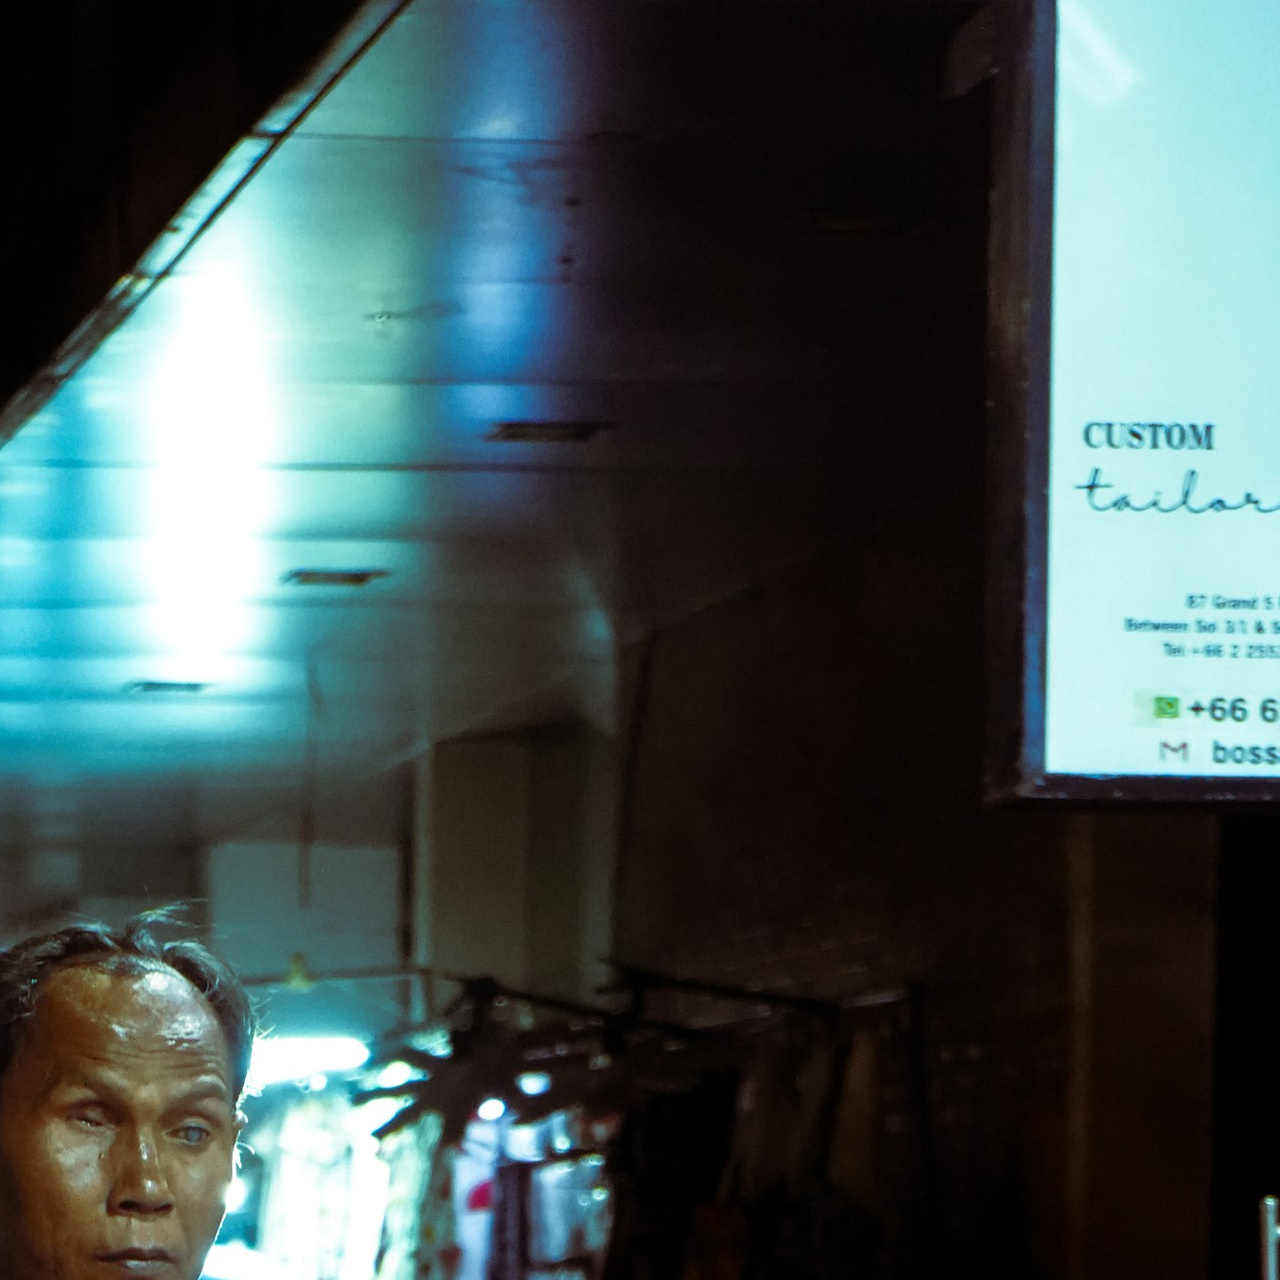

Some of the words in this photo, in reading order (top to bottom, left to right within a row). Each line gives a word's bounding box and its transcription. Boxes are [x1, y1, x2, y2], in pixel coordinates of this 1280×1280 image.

[1083, 422, 1216, 450] CUSTOM
[1124, 618, 1189, 634] Between
[1188, 697, 1248, 723] +66
